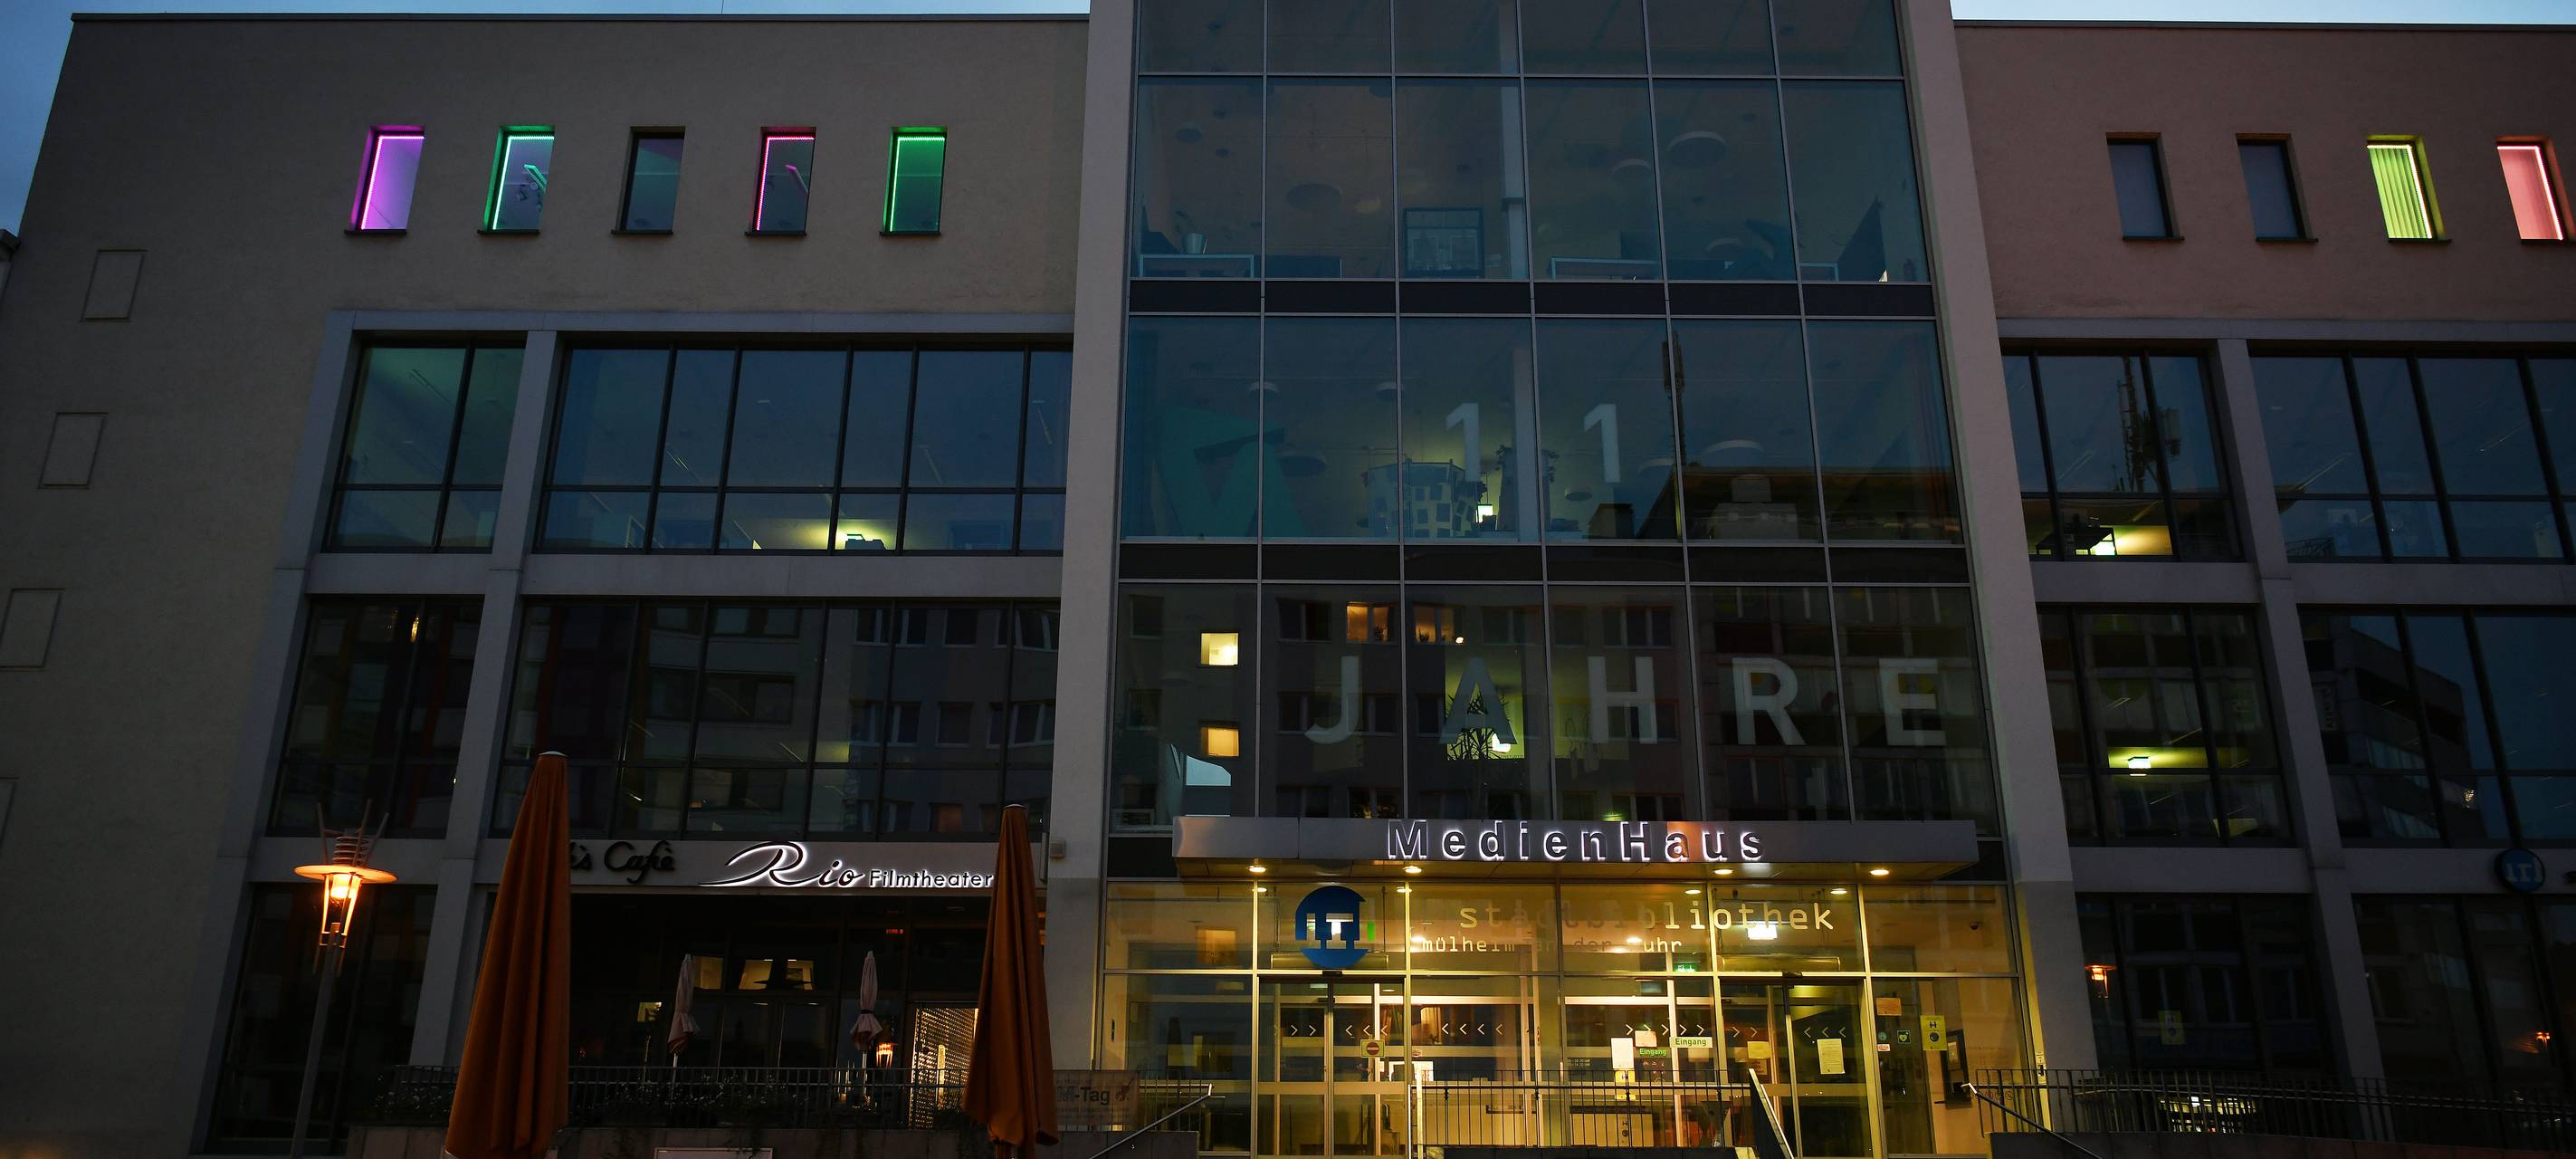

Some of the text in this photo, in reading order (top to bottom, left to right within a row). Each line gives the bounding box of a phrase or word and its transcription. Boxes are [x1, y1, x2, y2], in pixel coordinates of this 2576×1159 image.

[1304, 656, 1946, 745] JAHRE
[1388, 820, 1763, 860] MedienHaus
[698, 840, 994, 886] Rio Filmtheater
[1638, 1048, 1667, 1057] Eingang
[1674, 1038, 1707, 1047] Eingang
